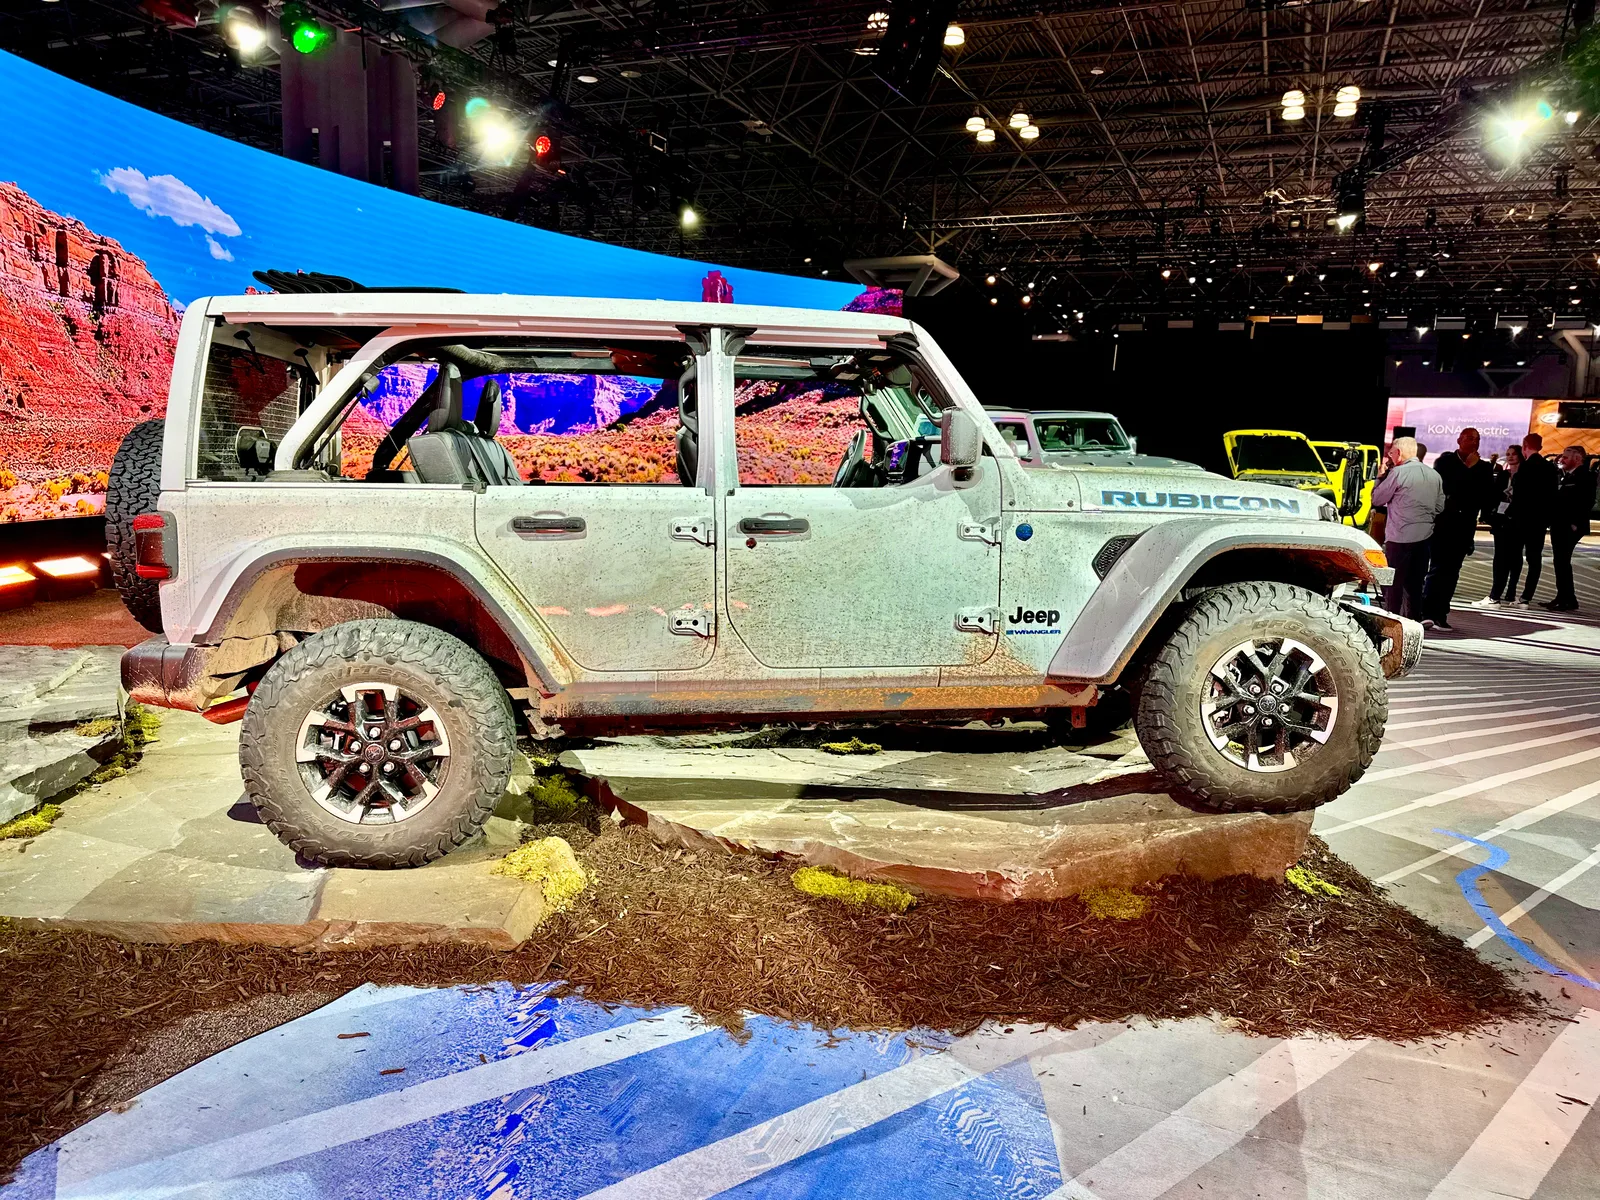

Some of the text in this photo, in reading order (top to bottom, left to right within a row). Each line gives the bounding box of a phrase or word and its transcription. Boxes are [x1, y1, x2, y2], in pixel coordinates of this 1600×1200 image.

[1427, 424, 1461, 434] KONA
[1101, 490, 1300, 514] RUBICON
[1009, 606, 1060, 626] Jeep
